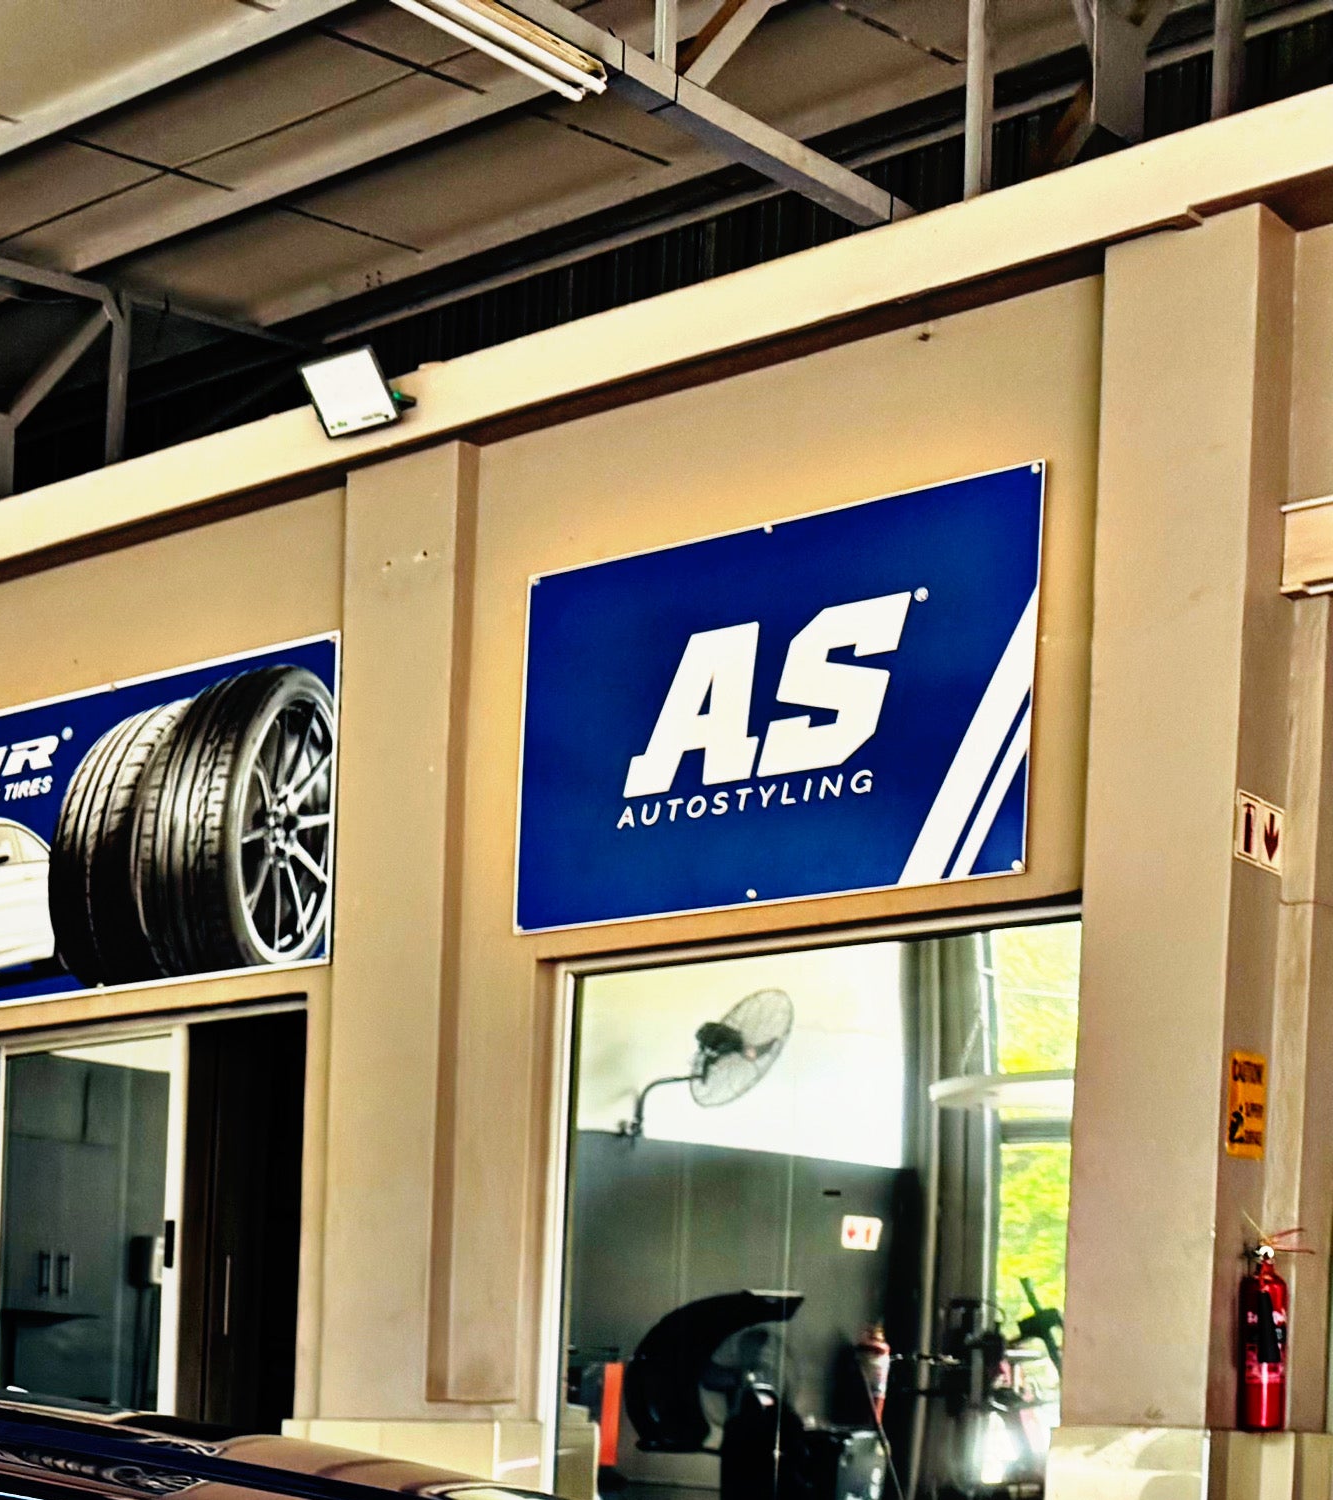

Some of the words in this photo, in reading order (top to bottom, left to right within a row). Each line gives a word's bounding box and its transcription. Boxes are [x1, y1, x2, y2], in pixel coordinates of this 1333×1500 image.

[623, 591, 911, 798] AS
[4, 776, 53, 802] TIRES
[617, 769, 874, 829] AUTOSTYLING
